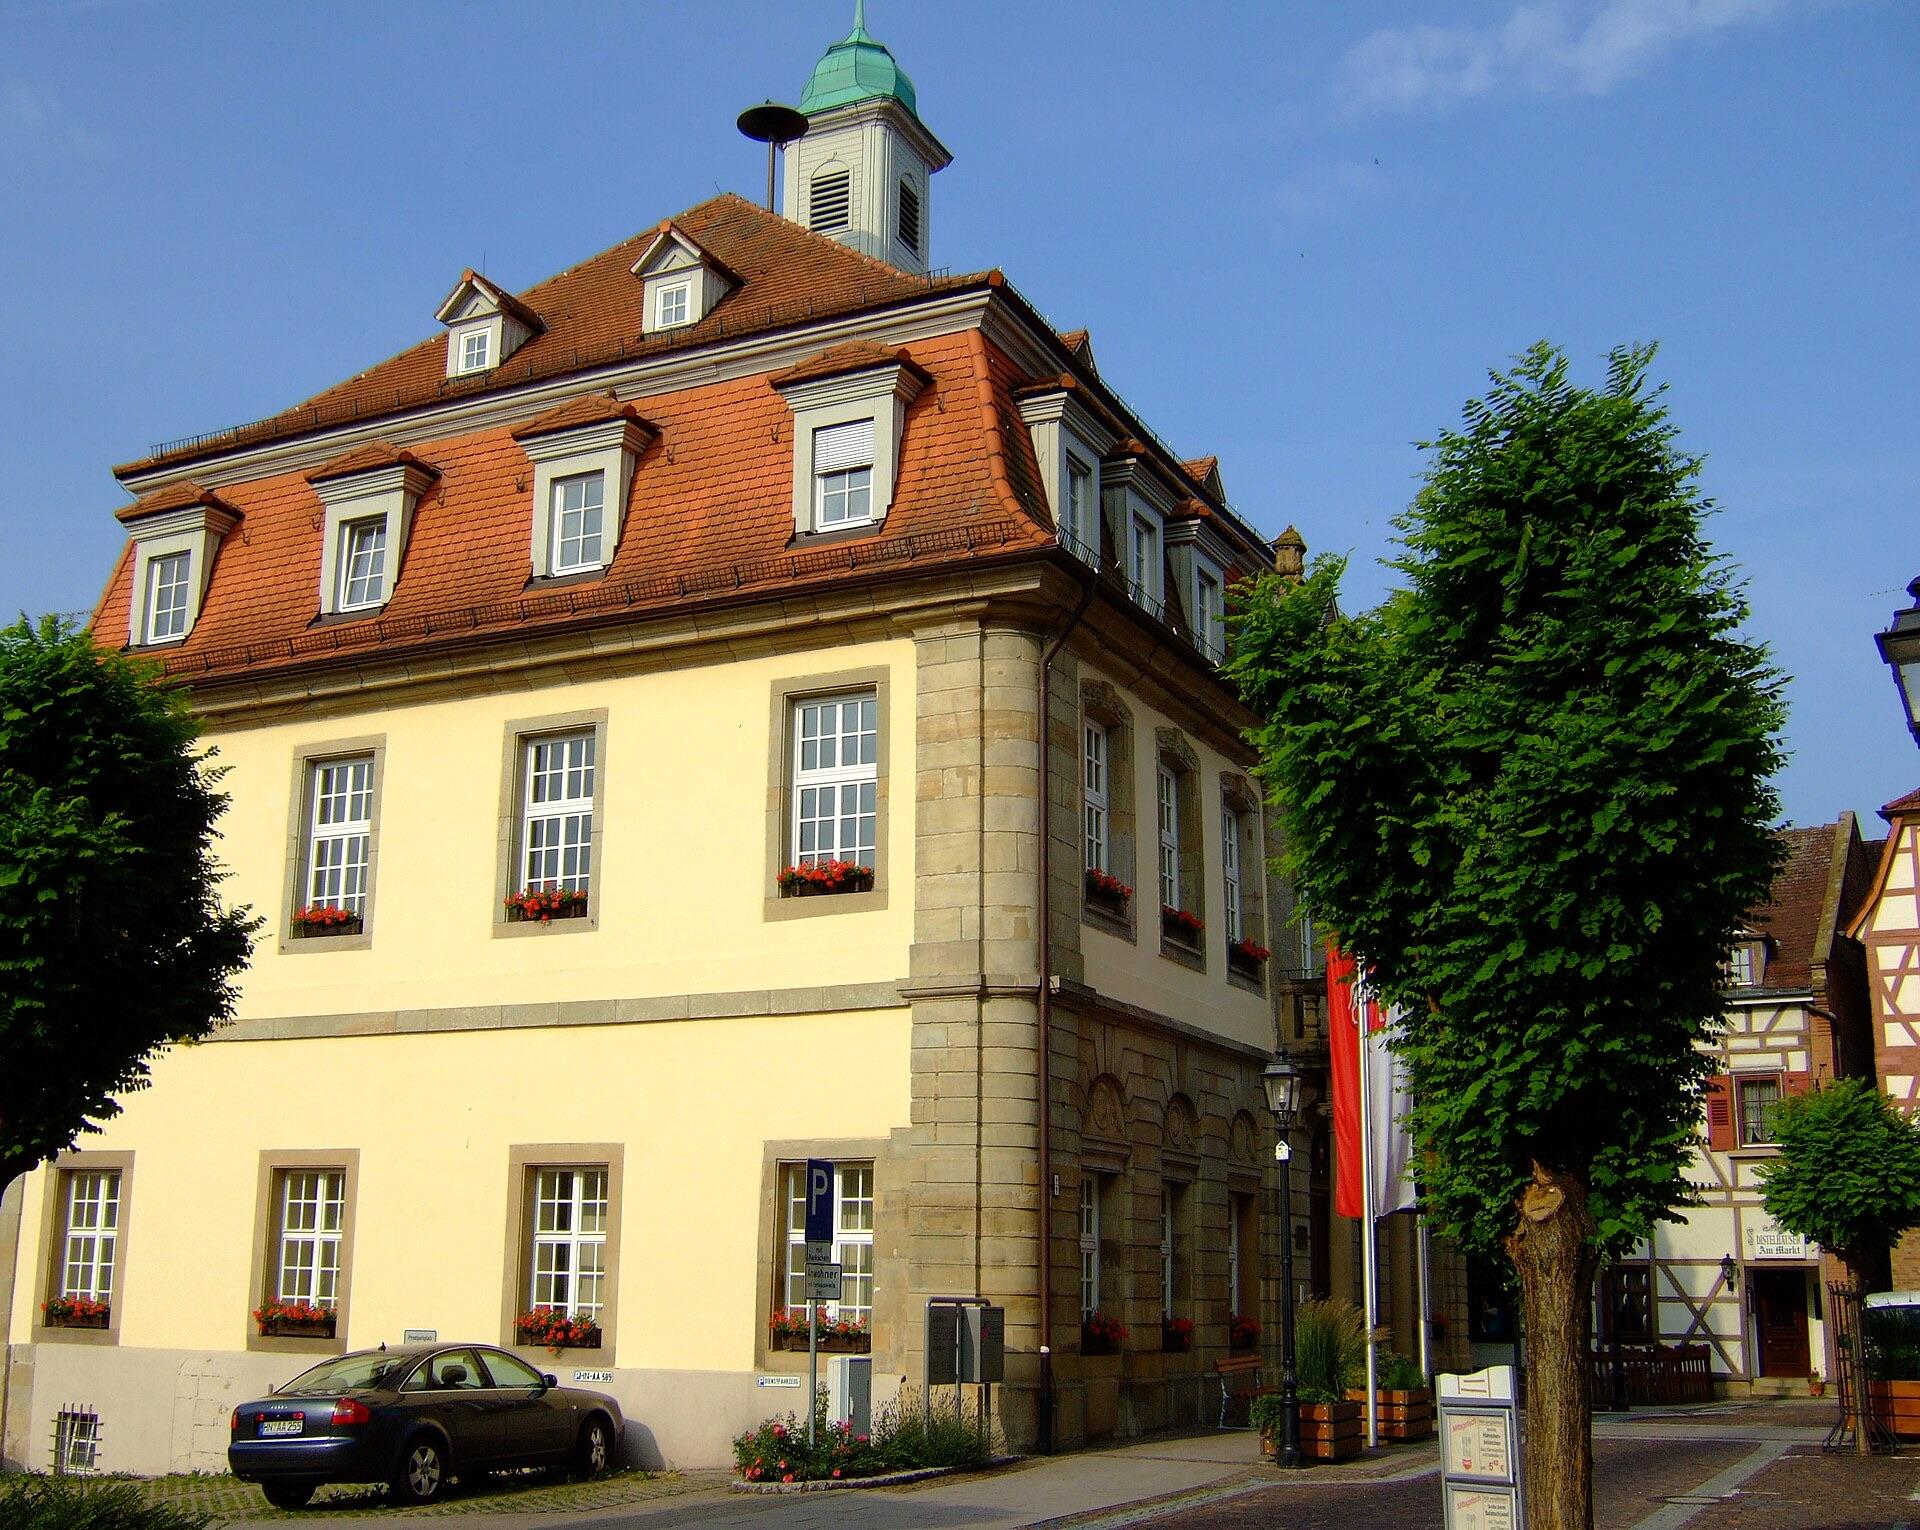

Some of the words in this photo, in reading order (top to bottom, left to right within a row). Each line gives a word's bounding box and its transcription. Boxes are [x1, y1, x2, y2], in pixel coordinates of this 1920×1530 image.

[811, 1168, 828, 1216] P
[1759, 1245, 1774, 1255] Am
[1775, 1245, 1801, 1255] Markt
